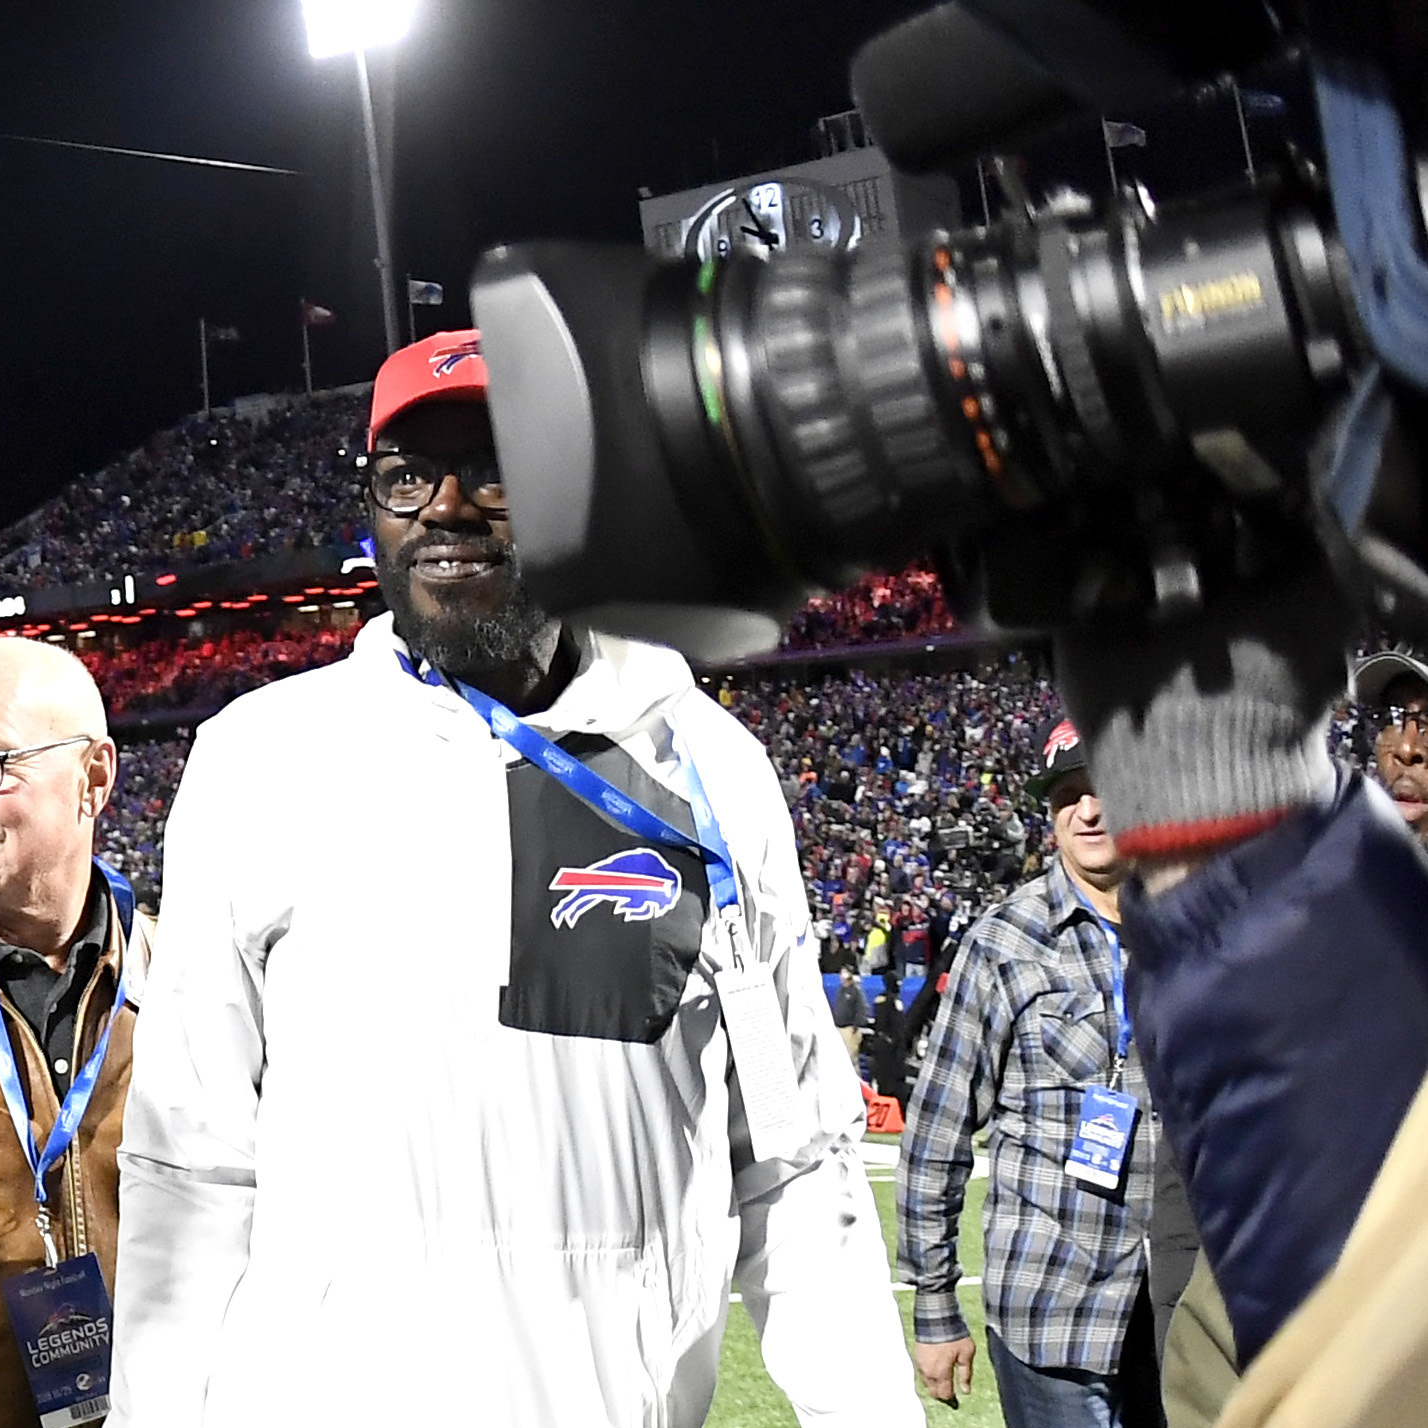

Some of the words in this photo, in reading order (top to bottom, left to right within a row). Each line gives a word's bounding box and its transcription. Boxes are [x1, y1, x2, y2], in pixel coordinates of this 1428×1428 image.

[752, 187, 778, 209] 12
[811, 218, 824, 240] 3
[26, 1317, 110, 1354] LEGENDS
[31, 1332, 111, 1368] COMMUNITY
